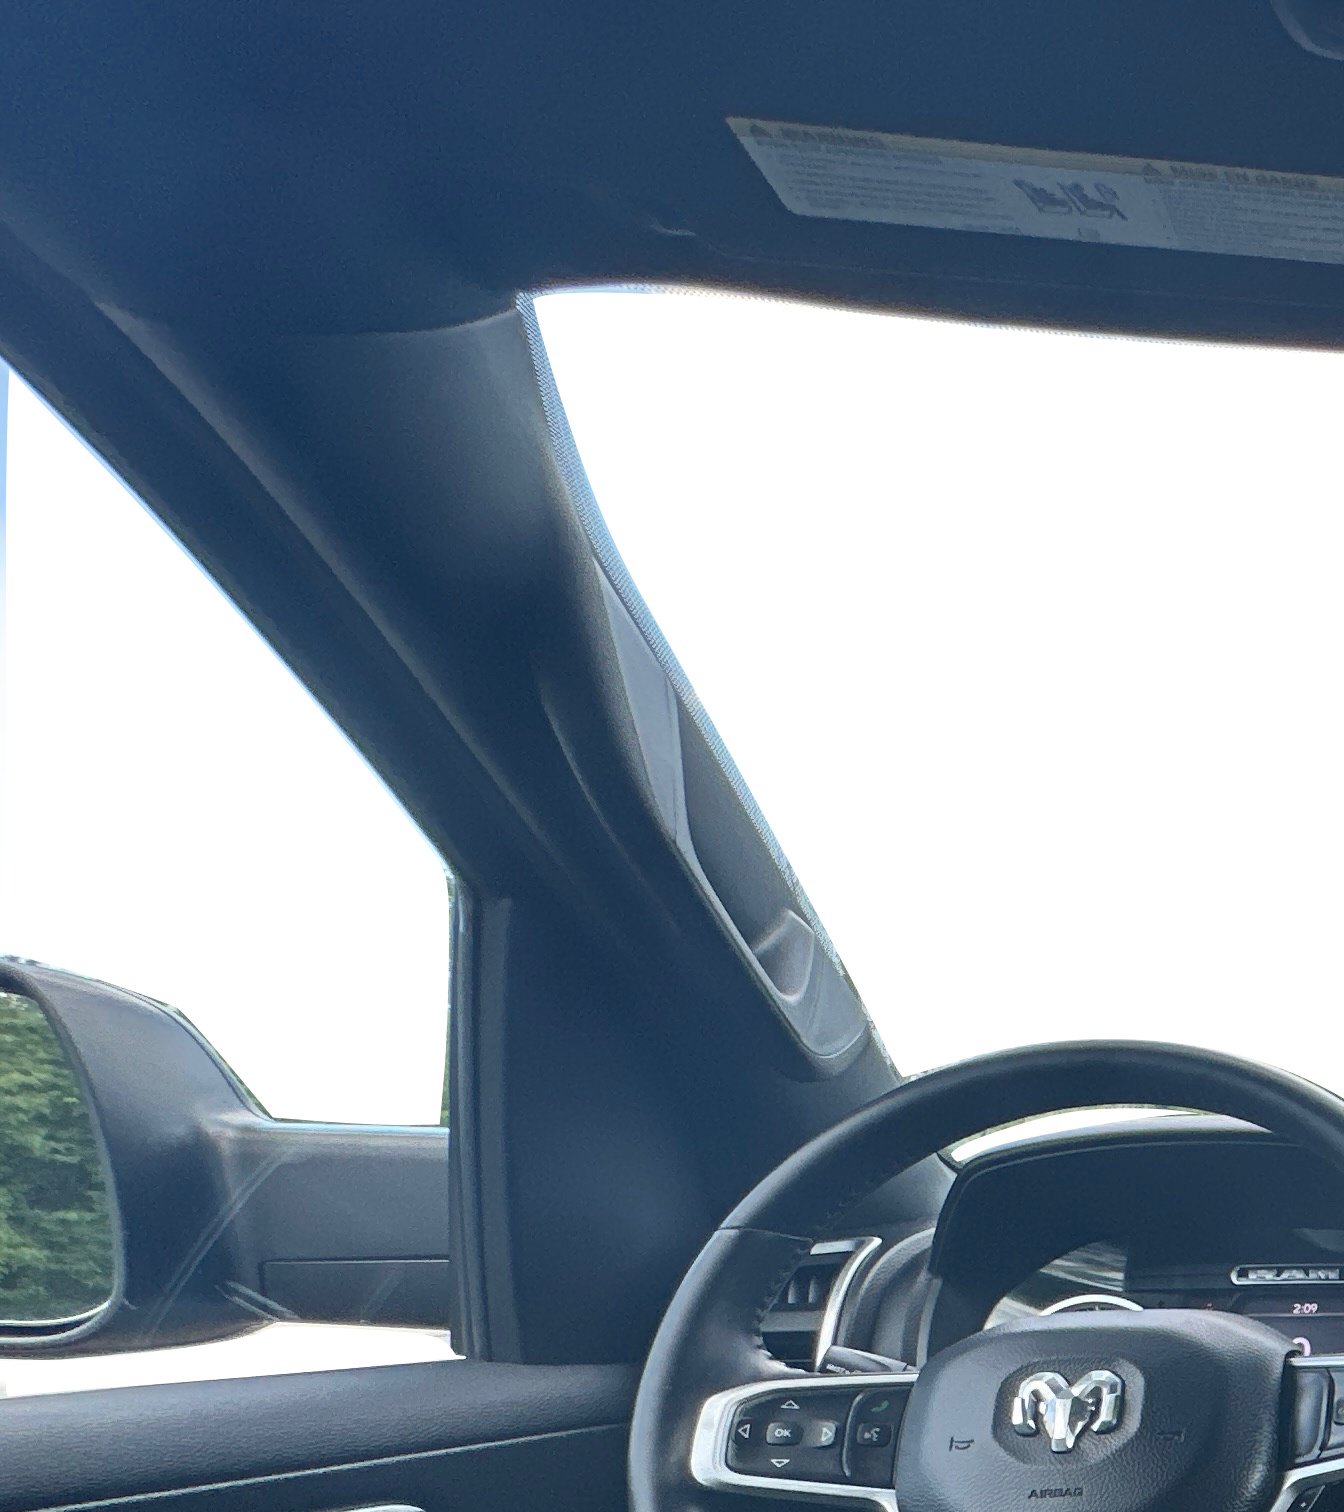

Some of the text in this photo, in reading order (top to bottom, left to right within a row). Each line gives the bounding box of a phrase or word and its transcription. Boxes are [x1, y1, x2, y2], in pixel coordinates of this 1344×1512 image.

[1247, 1267, 1341, 1281] RAM
[1292, 1302, 1319, 1315] 2:09
[774, 1427, 792, 1438] OK
[1027, 1486, 1084, 1500] AIRBAG
